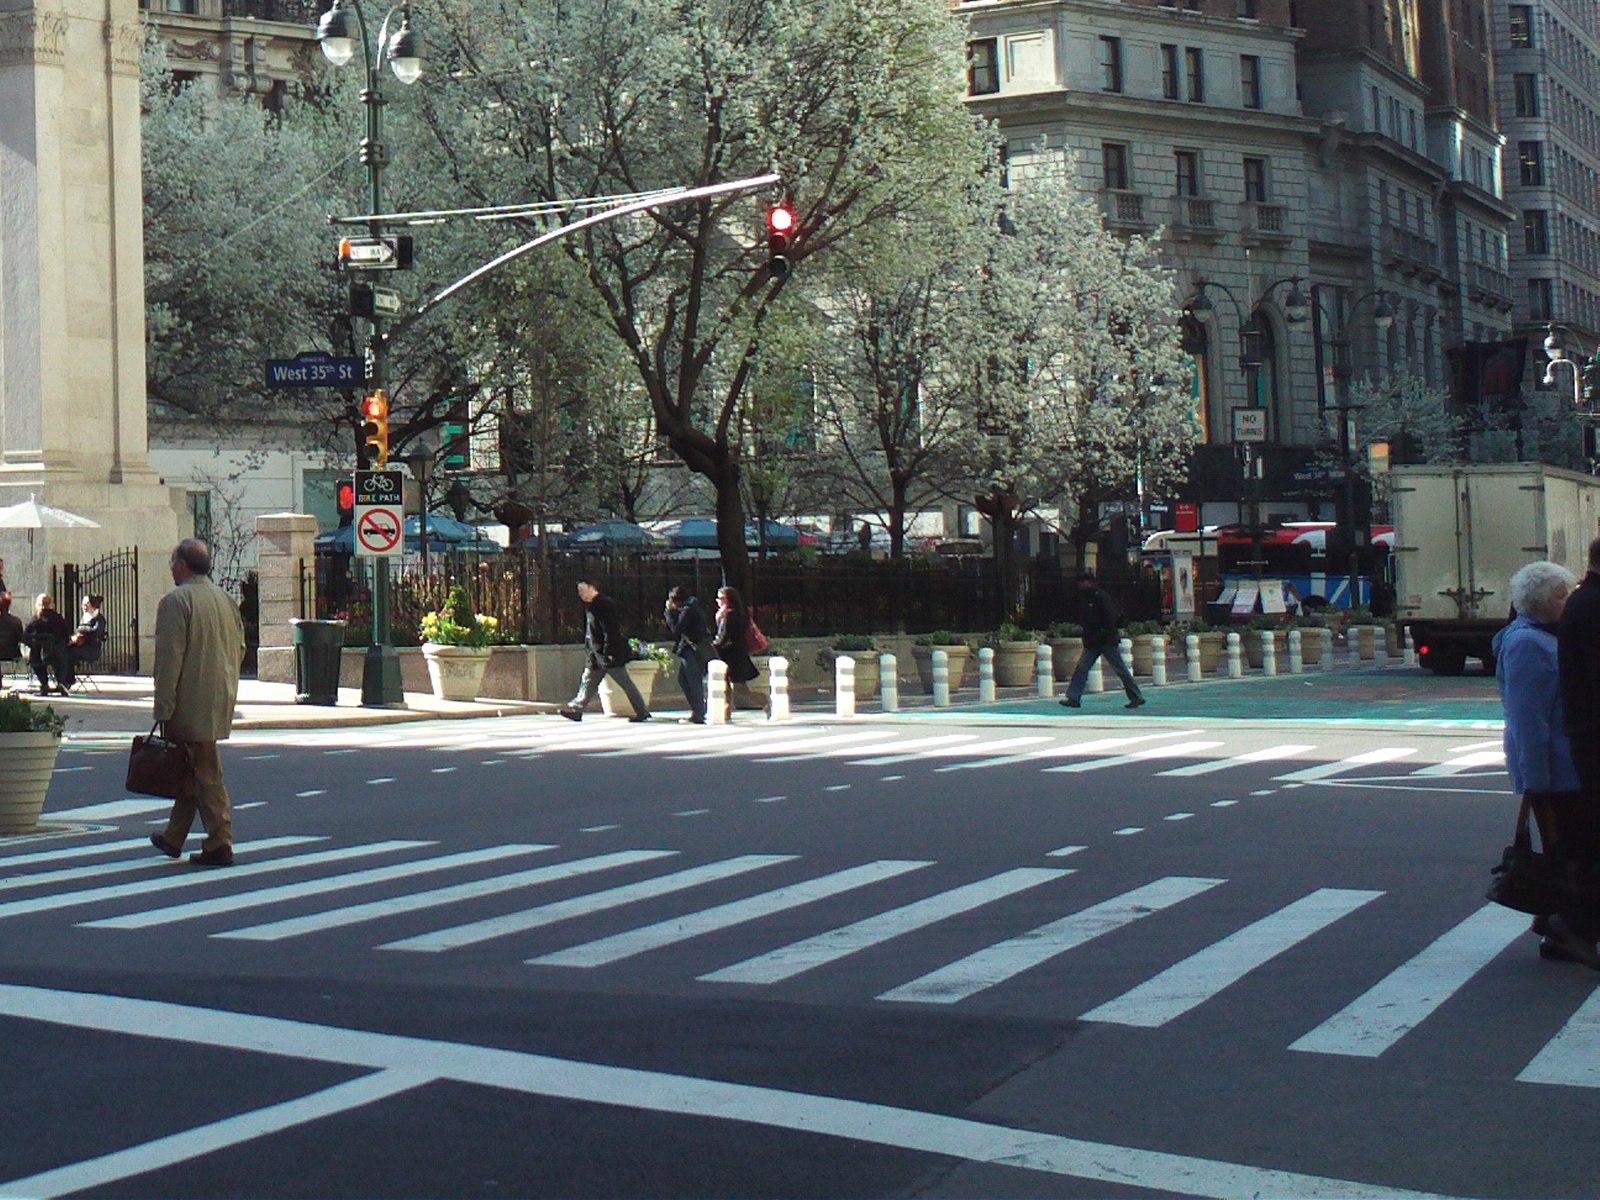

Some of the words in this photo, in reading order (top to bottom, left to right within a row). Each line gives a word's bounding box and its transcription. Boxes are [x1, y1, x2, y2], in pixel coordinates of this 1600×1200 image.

[273, 365, 308, 381] West
[310, 364, 336, 380] 35th
[339, 364, 353, 380] St
[1242, 414, 1257, 424] NO
[1236, 427, 1263, 437] TURNS
[379, 493, 400, 502] PATH
